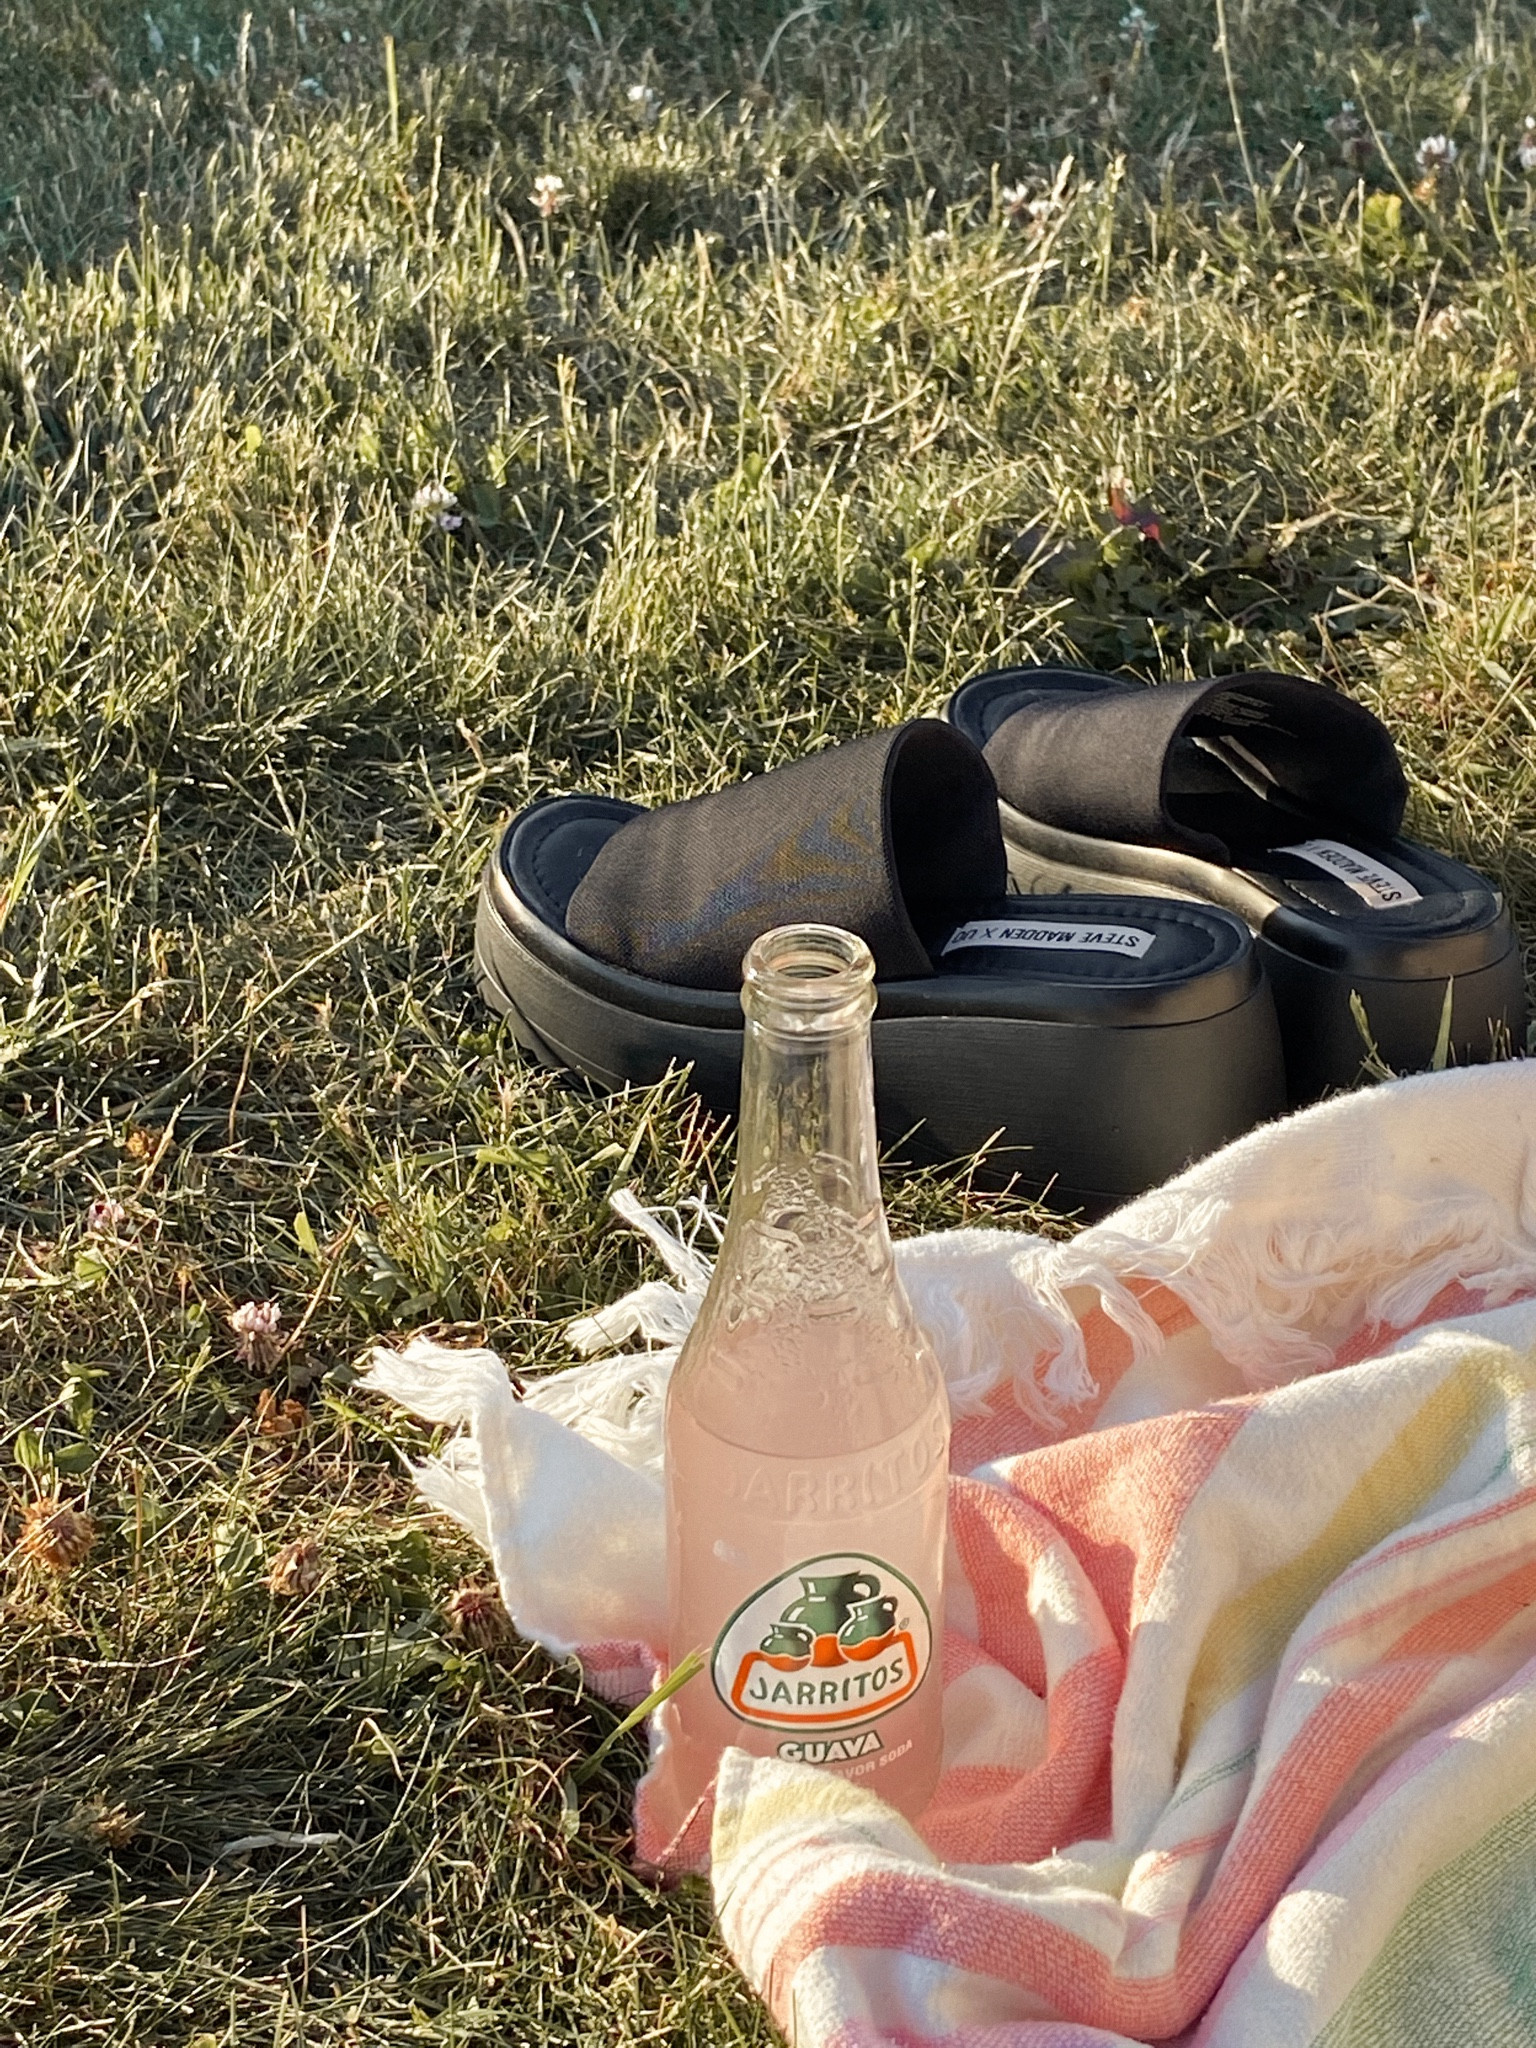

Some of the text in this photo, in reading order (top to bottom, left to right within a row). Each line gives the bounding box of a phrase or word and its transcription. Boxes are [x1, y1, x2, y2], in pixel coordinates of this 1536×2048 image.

[980, 926, 998, 939] X
[1000, 927, 1077, 943] MADDEN
[1079, 931, 1141, 948] STEVE
[749, 1657, 904, 1705] JARRITOS
[777, 1730, 884, 1765] GUAVA
[878, 1739, 914, 1768] SODA
